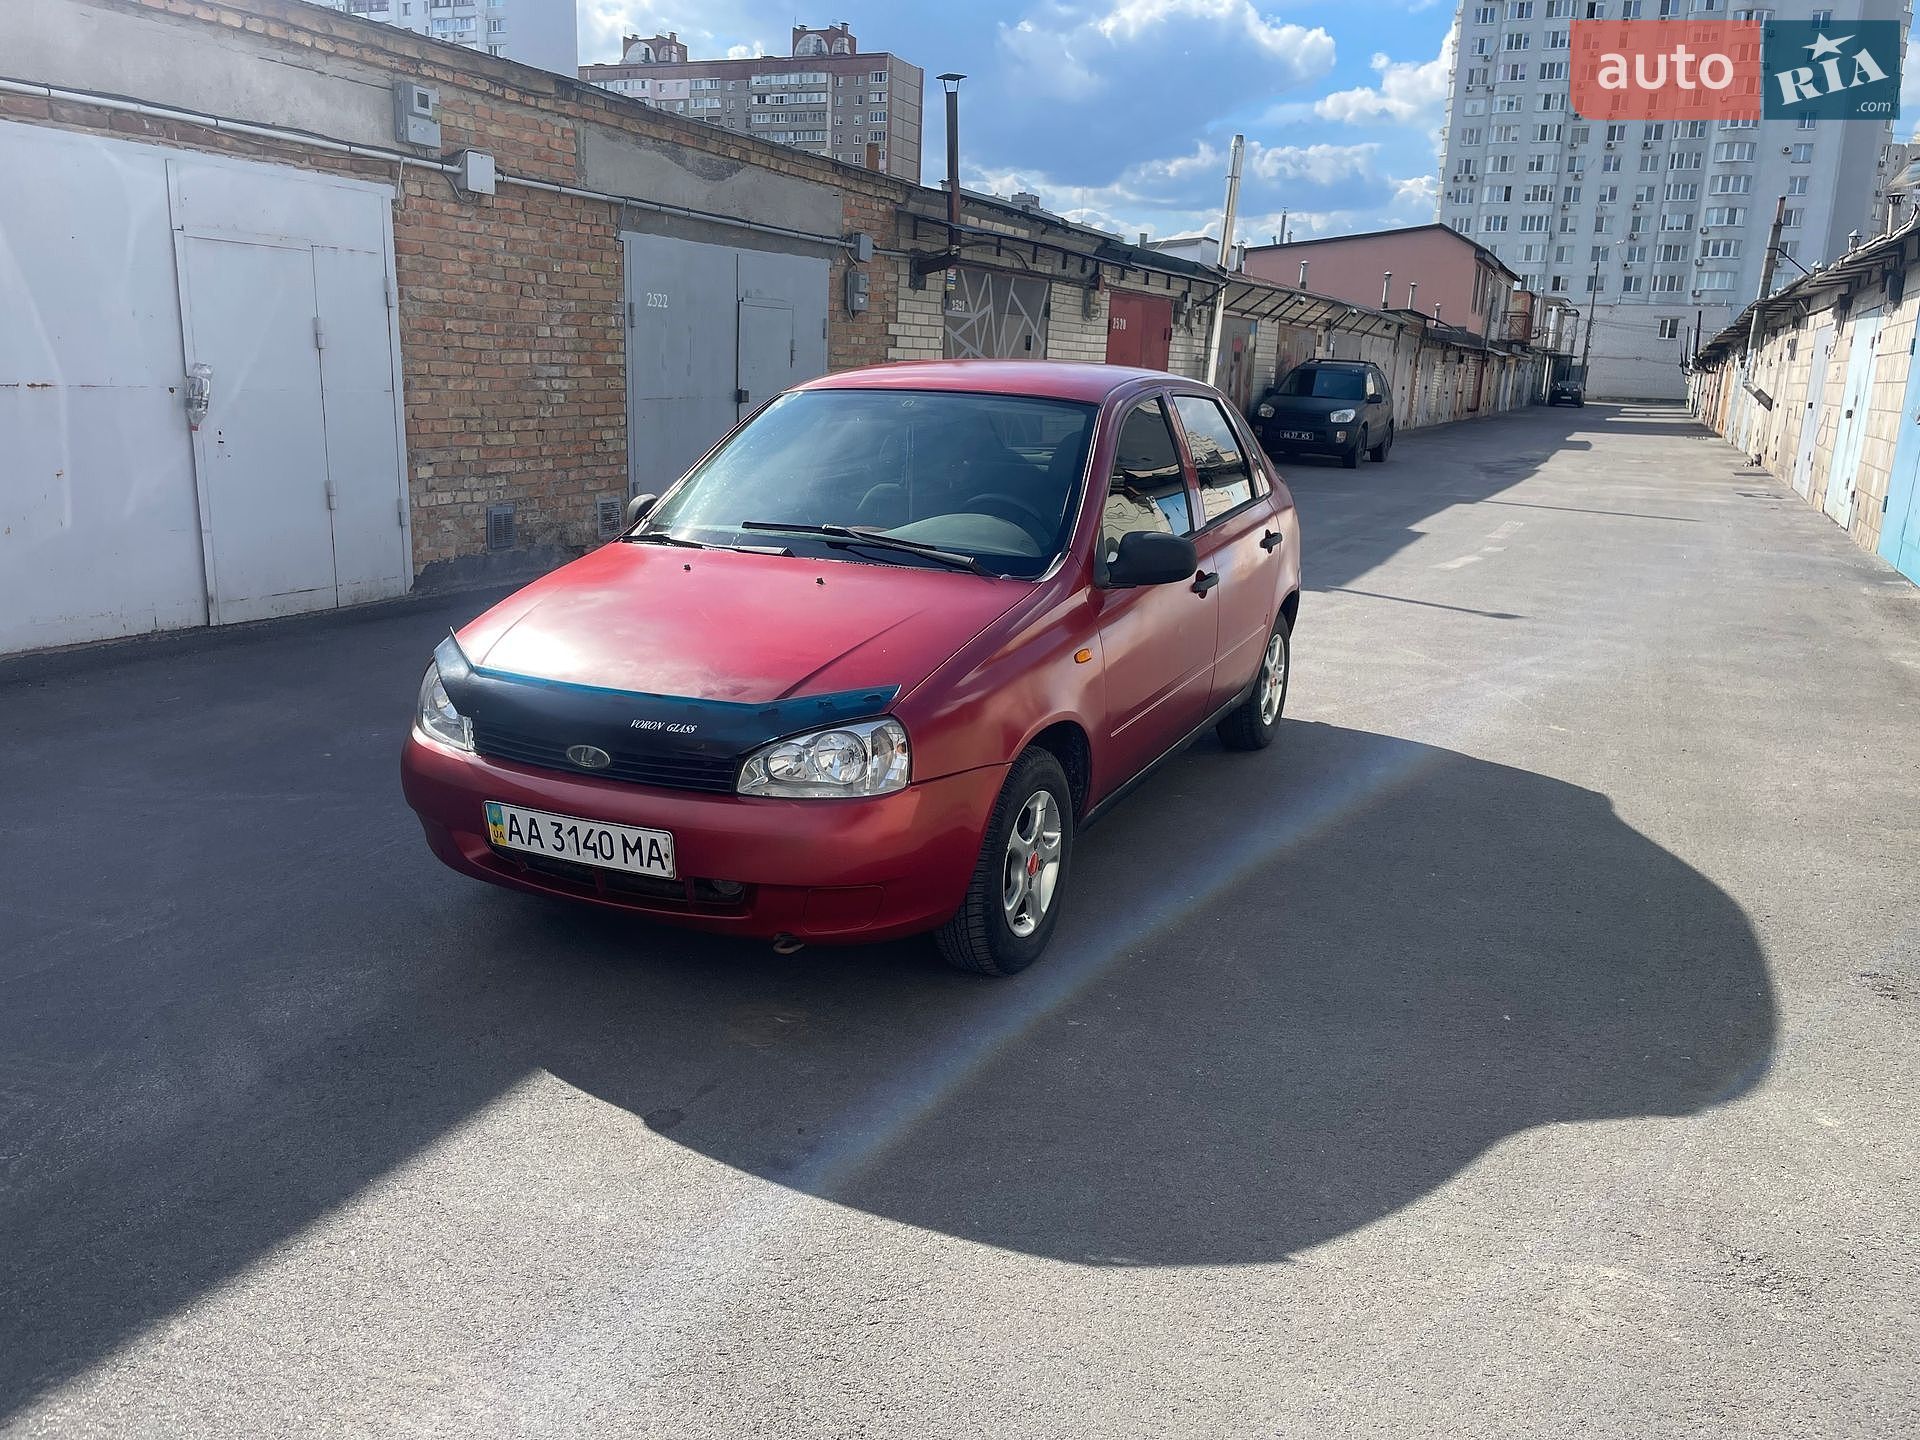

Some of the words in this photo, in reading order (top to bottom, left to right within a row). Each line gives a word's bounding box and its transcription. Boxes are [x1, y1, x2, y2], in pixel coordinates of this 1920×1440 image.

[646, 292, 668, 308] 2522
[630, 719, 665, 730] VORON
[666, 723, 698, 734] GLASS
[493, 830, 506, 841] UA
[508, 813, 545, 849] AA
[550, 821, 615, 861] 3140
[621, 833, 666, 871] MA
